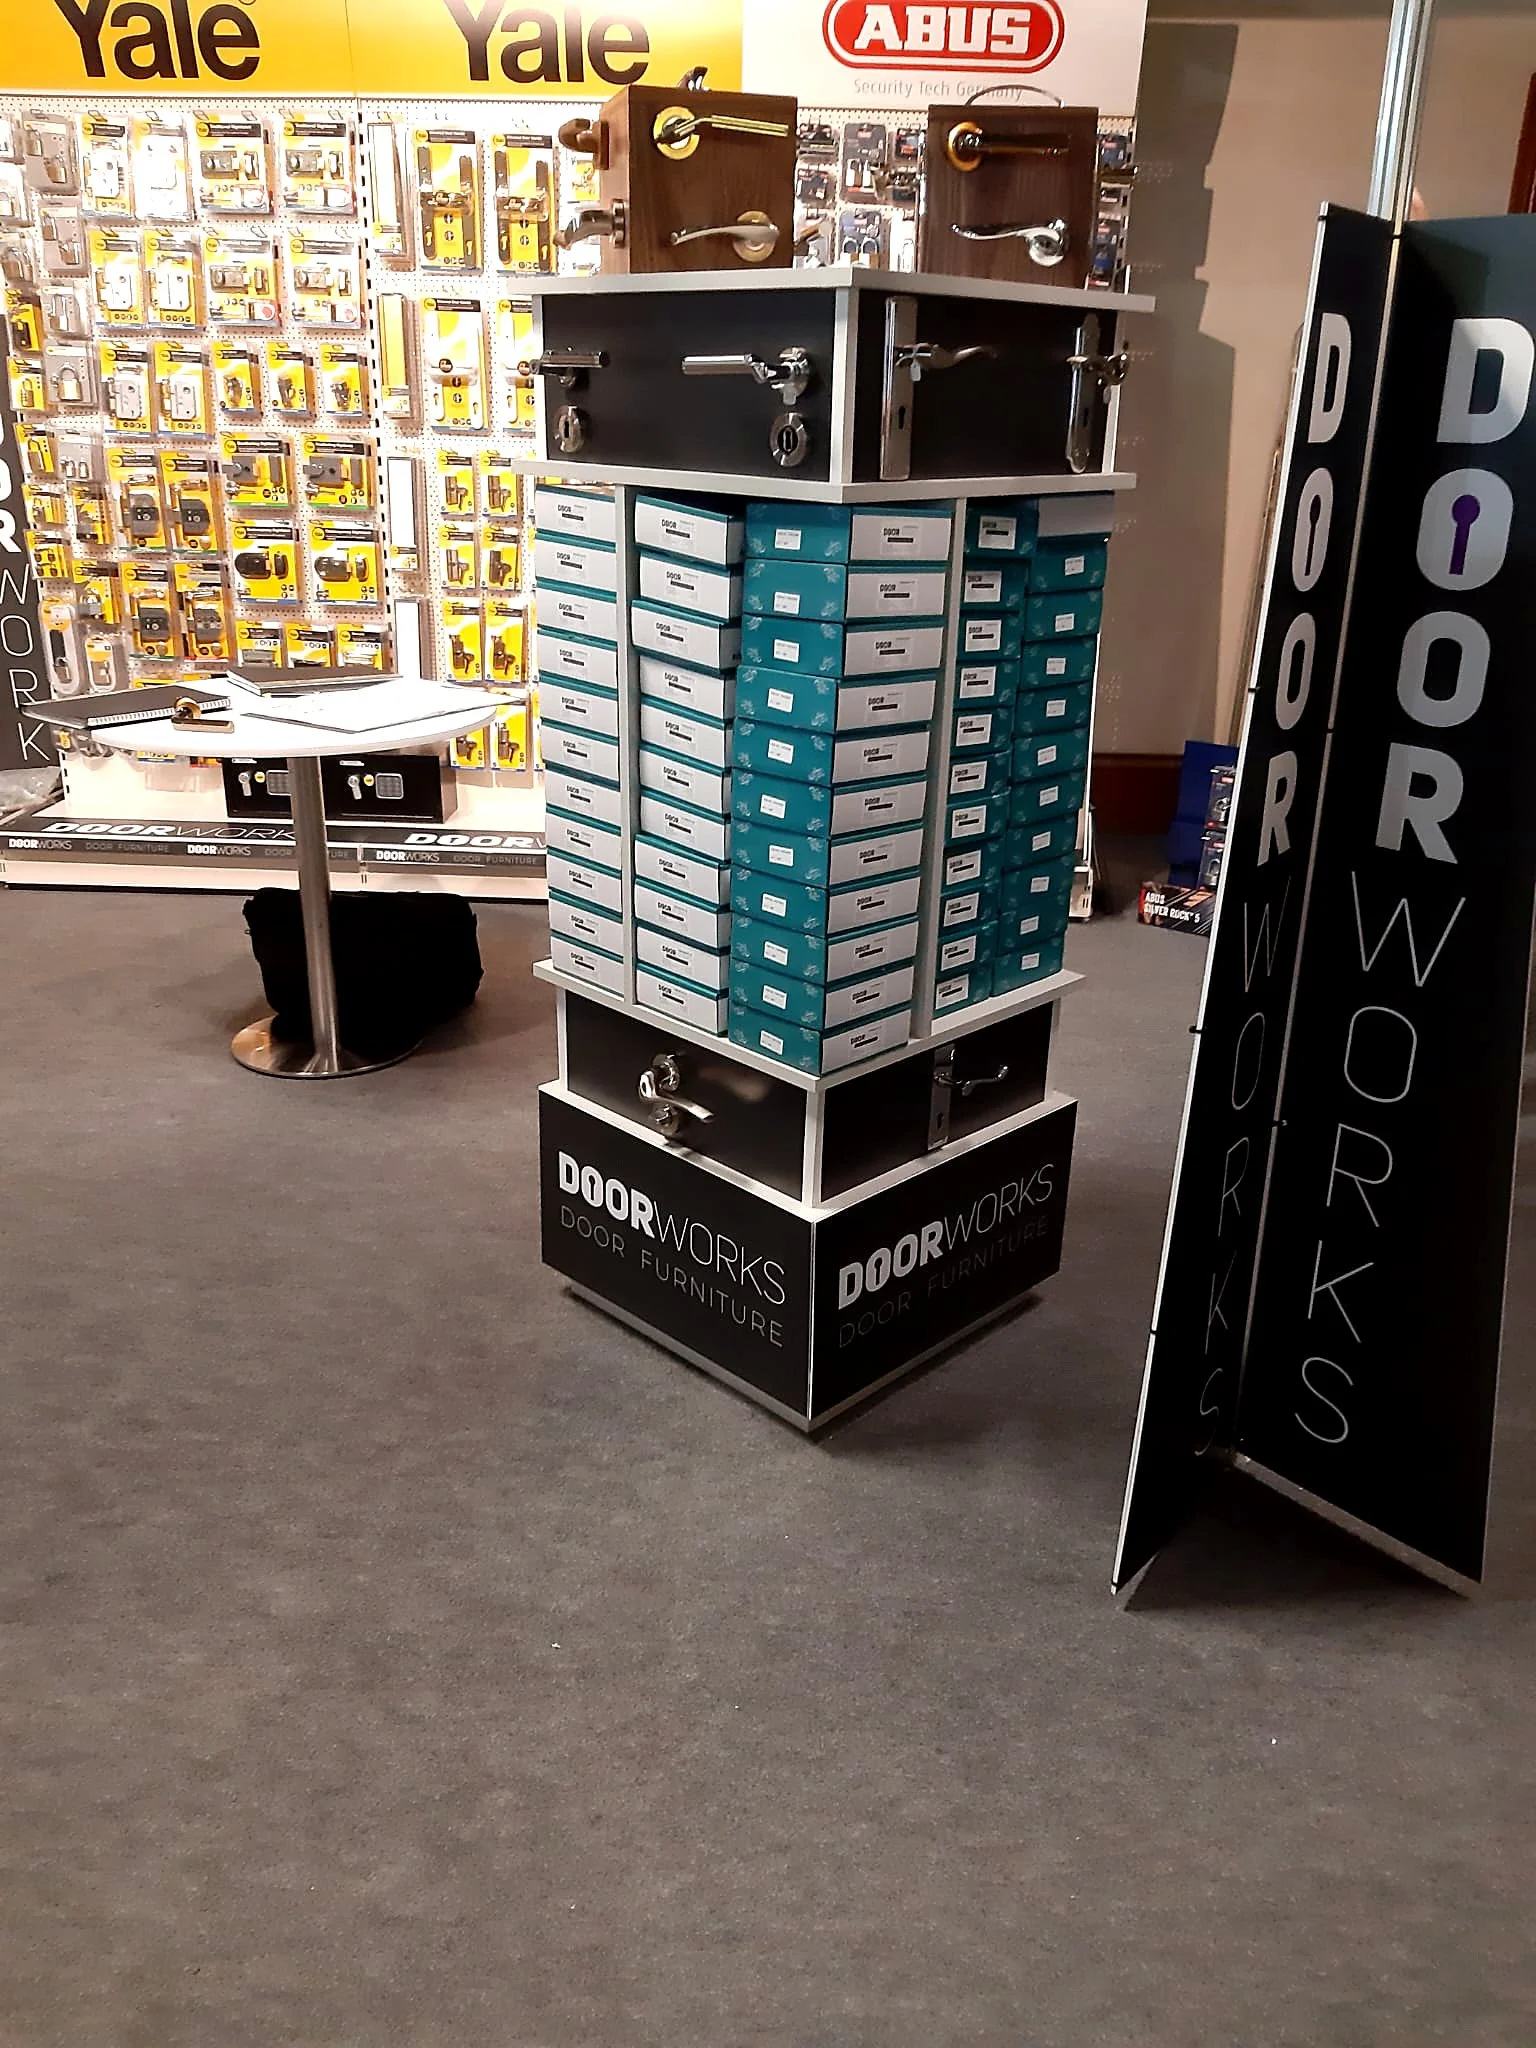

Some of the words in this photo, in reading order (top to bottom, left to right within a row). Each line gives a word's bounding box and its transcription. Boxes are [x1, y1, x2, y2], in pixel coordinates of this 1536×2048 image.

[55, 0, 260, 81] Yale
[443, 0, 650, 85] Yale
[853, 4, 1031, 54] ABUS
[853, 78, 913, 98] Security
[919, 80, 950, 97] Tech
[8, 838, 73, 851] DOORWORKS
[42, 822, 295, 840] DOORWORK
[187, 844, 252, 857] DOORWORKS
[376, 850, 440, 863] DOORWORKS
[1294, 317, 1536, 1444] DOORWORKS
[558, 1150, 786, 1305] DOORWORKS
[838, 1162, 1055, 1310] DOORWORKS
[560, 1205, 625, 1258] DOOR
[640, 1249, 784, 1348] FURNITURE
[839, 1290, 913, 1349] DOOR
[927, 1214, 1050, 1299] FURNITURE
